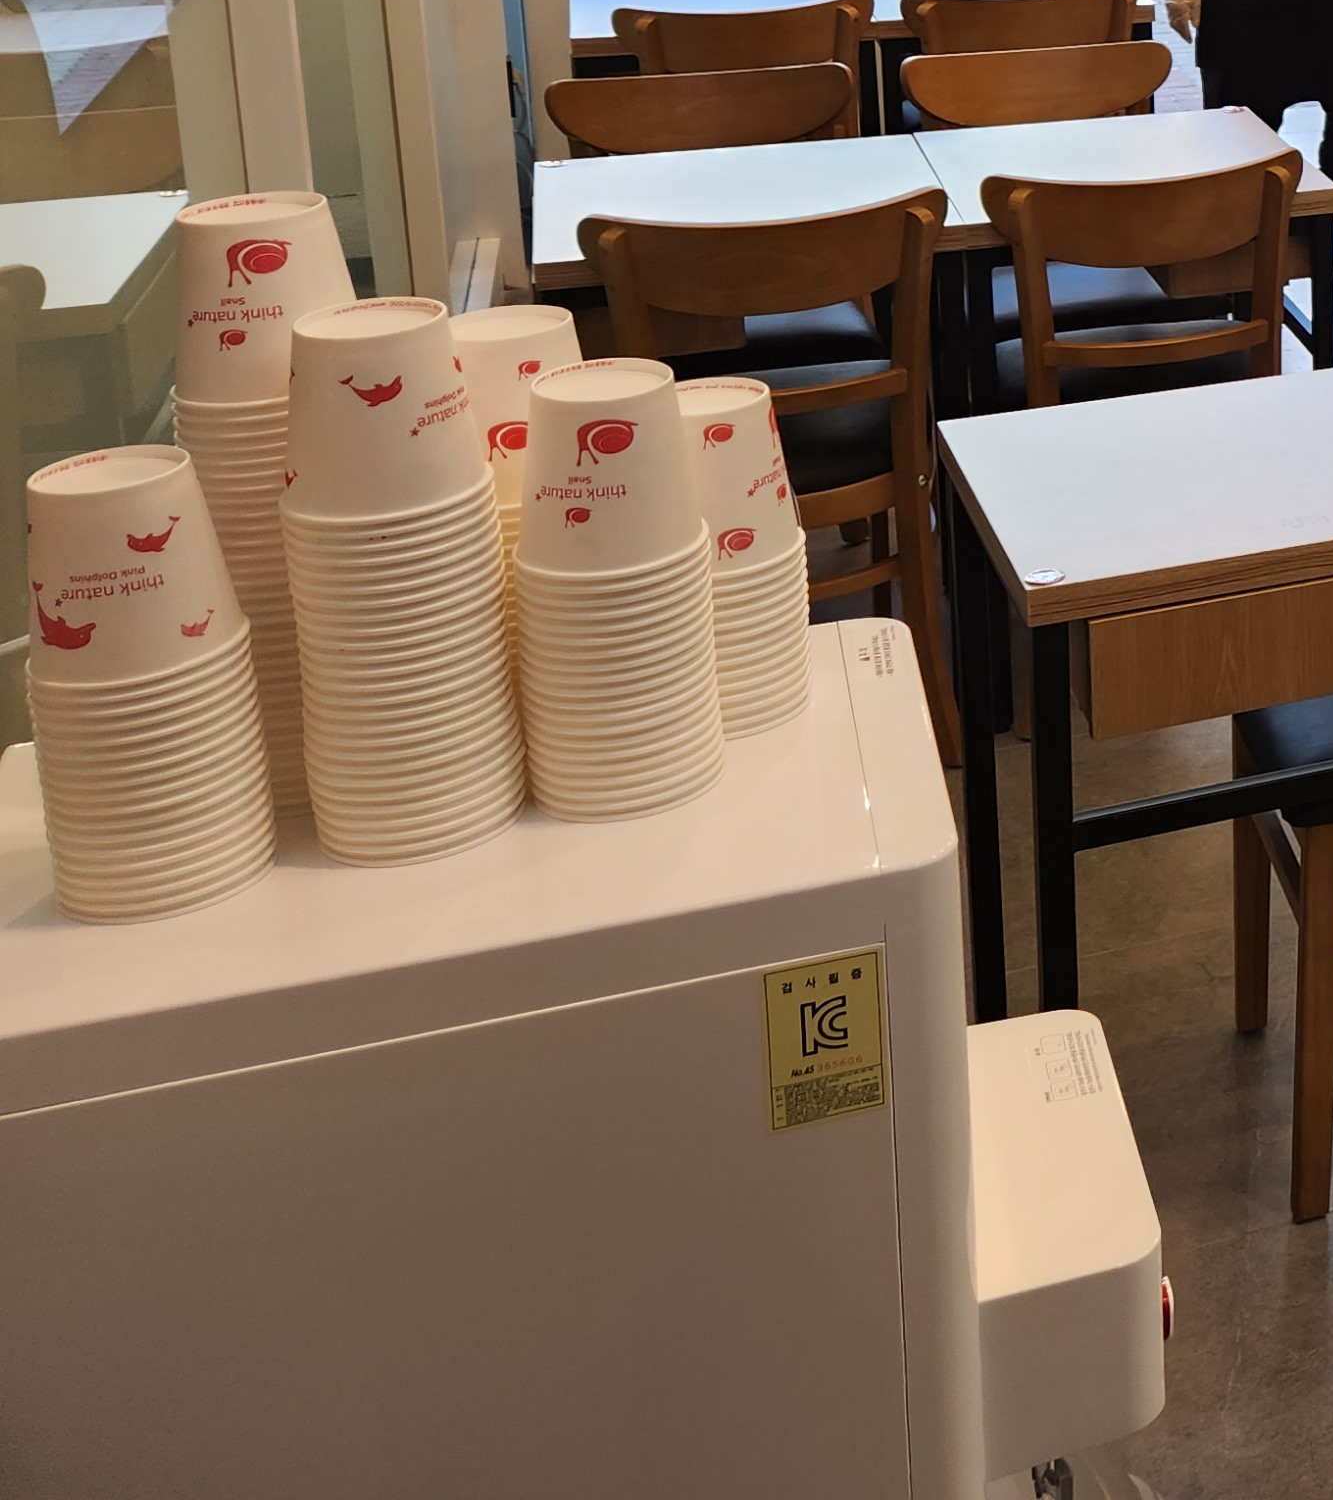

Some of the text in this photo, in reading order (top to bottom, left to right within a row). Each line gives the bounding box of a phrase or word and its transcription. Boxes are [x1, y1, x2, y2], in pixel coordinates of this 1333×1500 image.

[220, 296, 245, 306] Snail
[192, 304, 284, 324] think nature
[417, 405, 458, 429] nature
[567, 475, 592, 486] Snail
[540, 484, 627, 501] think nature
[69, 564, 146, 584] Pink Dolphins
[60, 573, 164, 600] think nature
[800, 995, 848, 1057] KC
